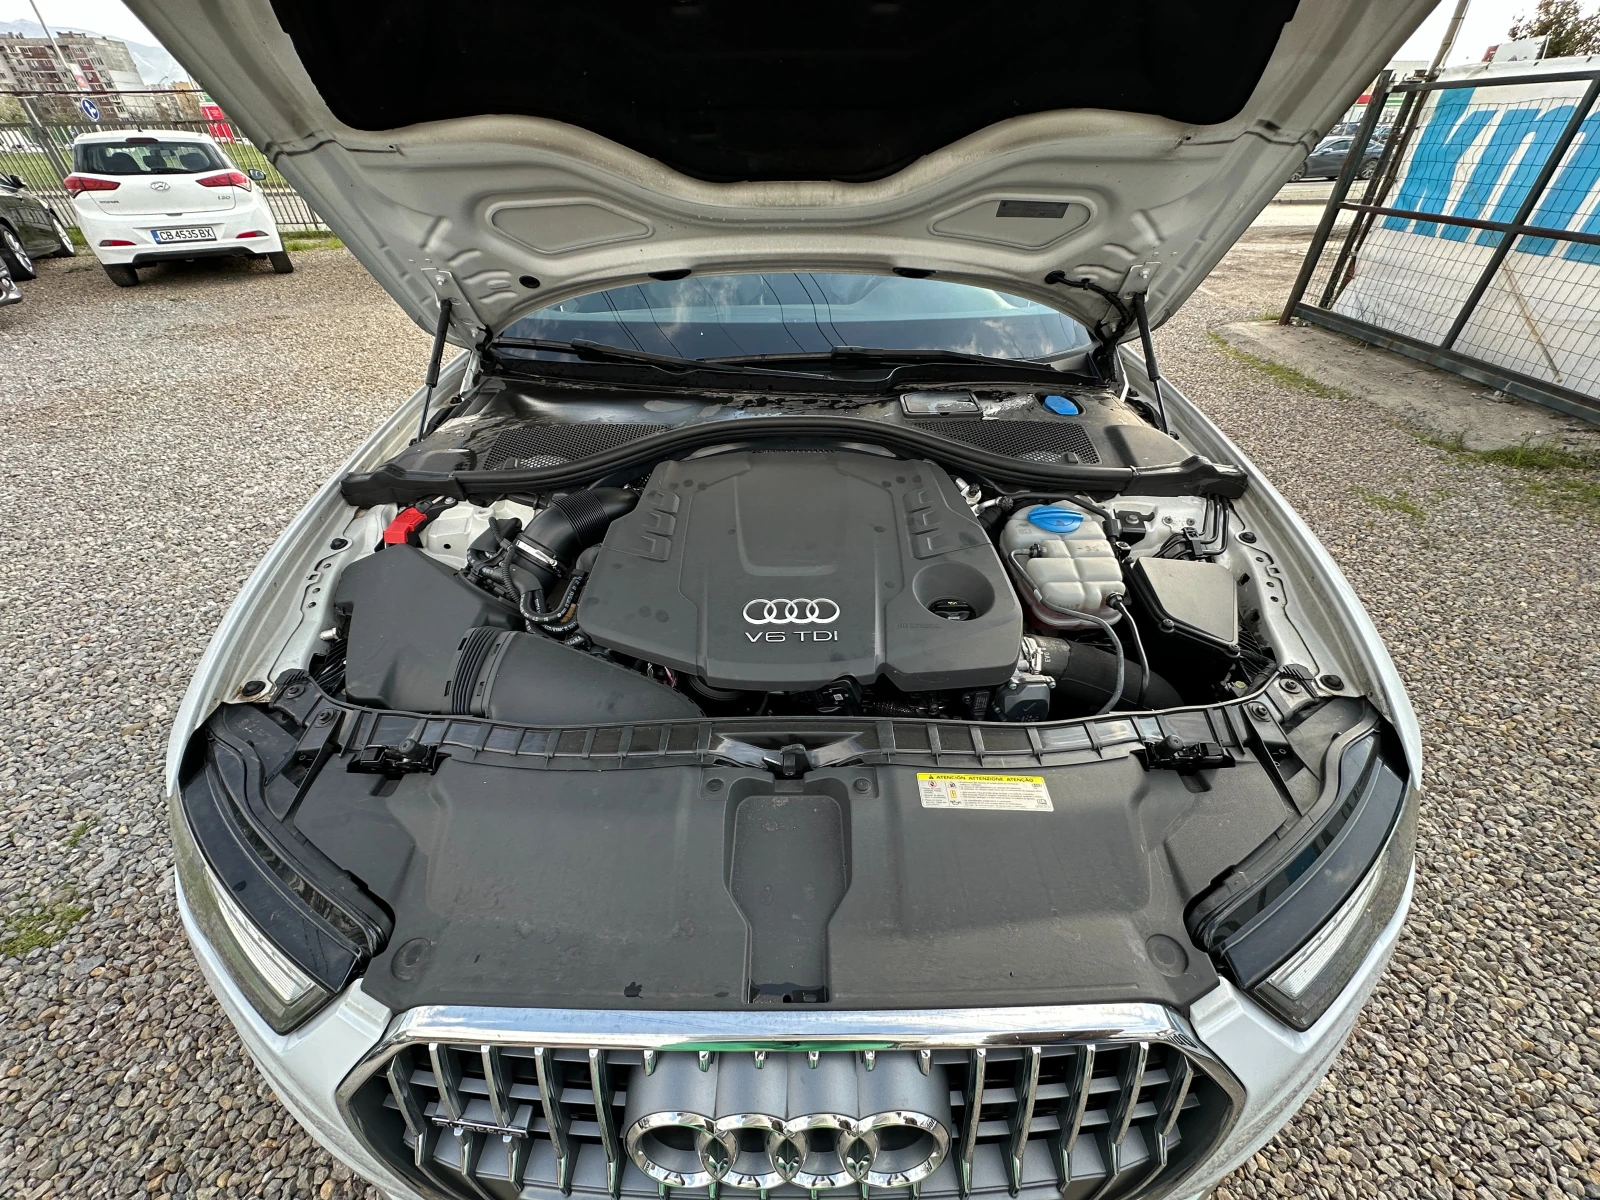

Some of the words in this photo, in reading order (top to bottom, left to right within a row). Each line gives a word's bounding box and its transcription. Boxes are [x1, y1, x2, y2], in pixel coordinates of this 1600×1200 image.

[160, 231, 174, 239] CB
[175, 229, 198, 239] 4535
[199, 228, 213, 238] BX
[744, 631, 786, 643] V6
[793, 630, 838, 642] TDI
